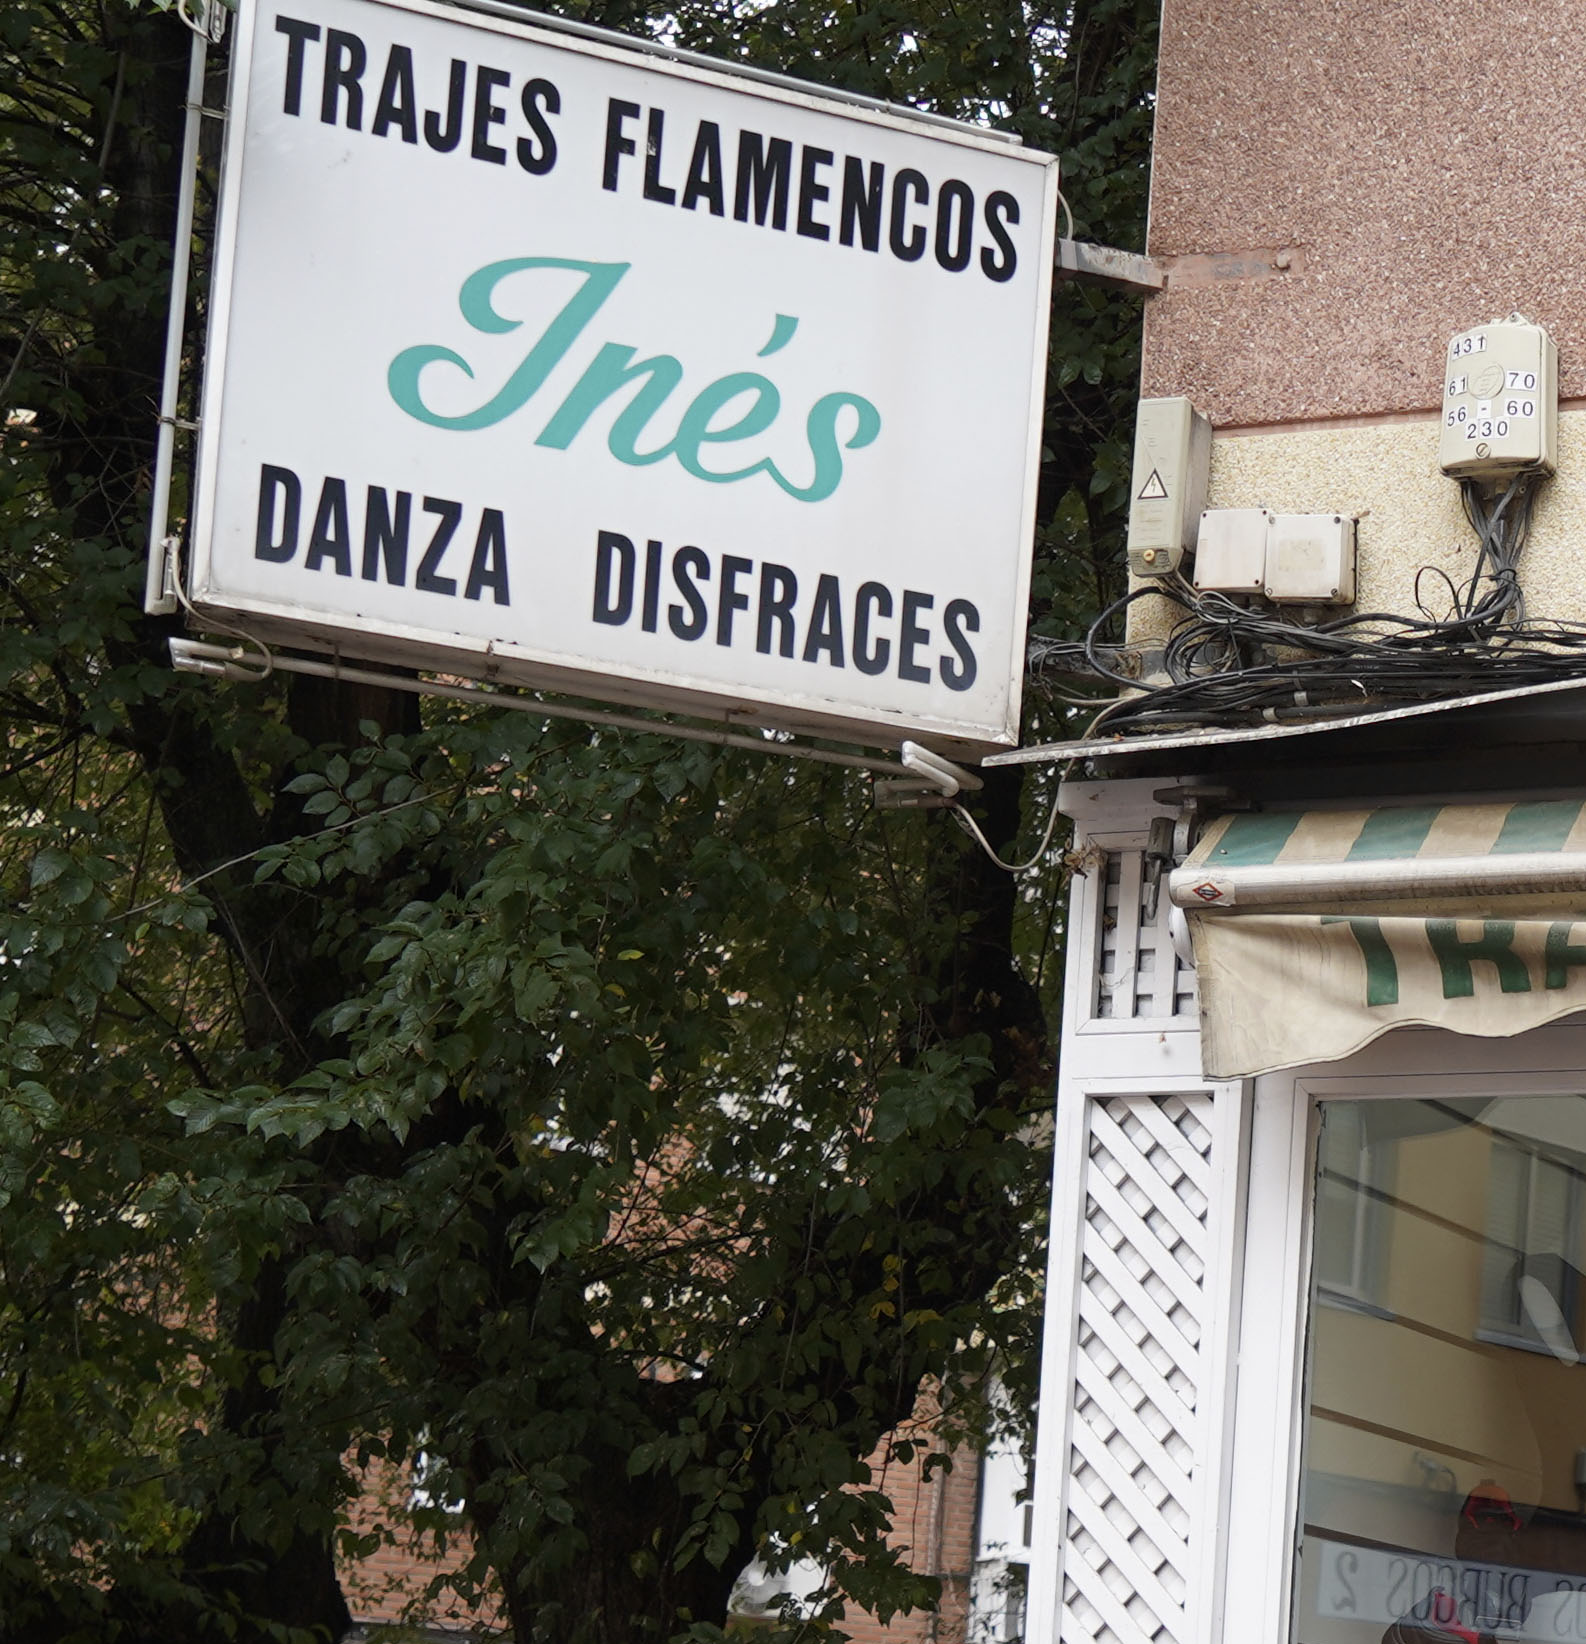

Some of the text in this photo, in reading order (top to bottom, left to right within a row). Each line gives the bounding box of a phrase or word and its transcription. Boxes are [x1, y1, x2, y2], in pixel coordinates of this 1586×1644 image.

[274, 17, 1021, 282] TRAJES FLAMENCOS
[1453, 336, 1485, 357] 431
[387, 256, 882, 503] Inés
[1448, 372, 1535, 396] 61 70
[1447, 406, 1466, 427] 56
[1506, 400, 1533, 417] 60
[1467, 420, 1508, 439] 230
[255, 463, 981, 691] DANZA DISFRACES
